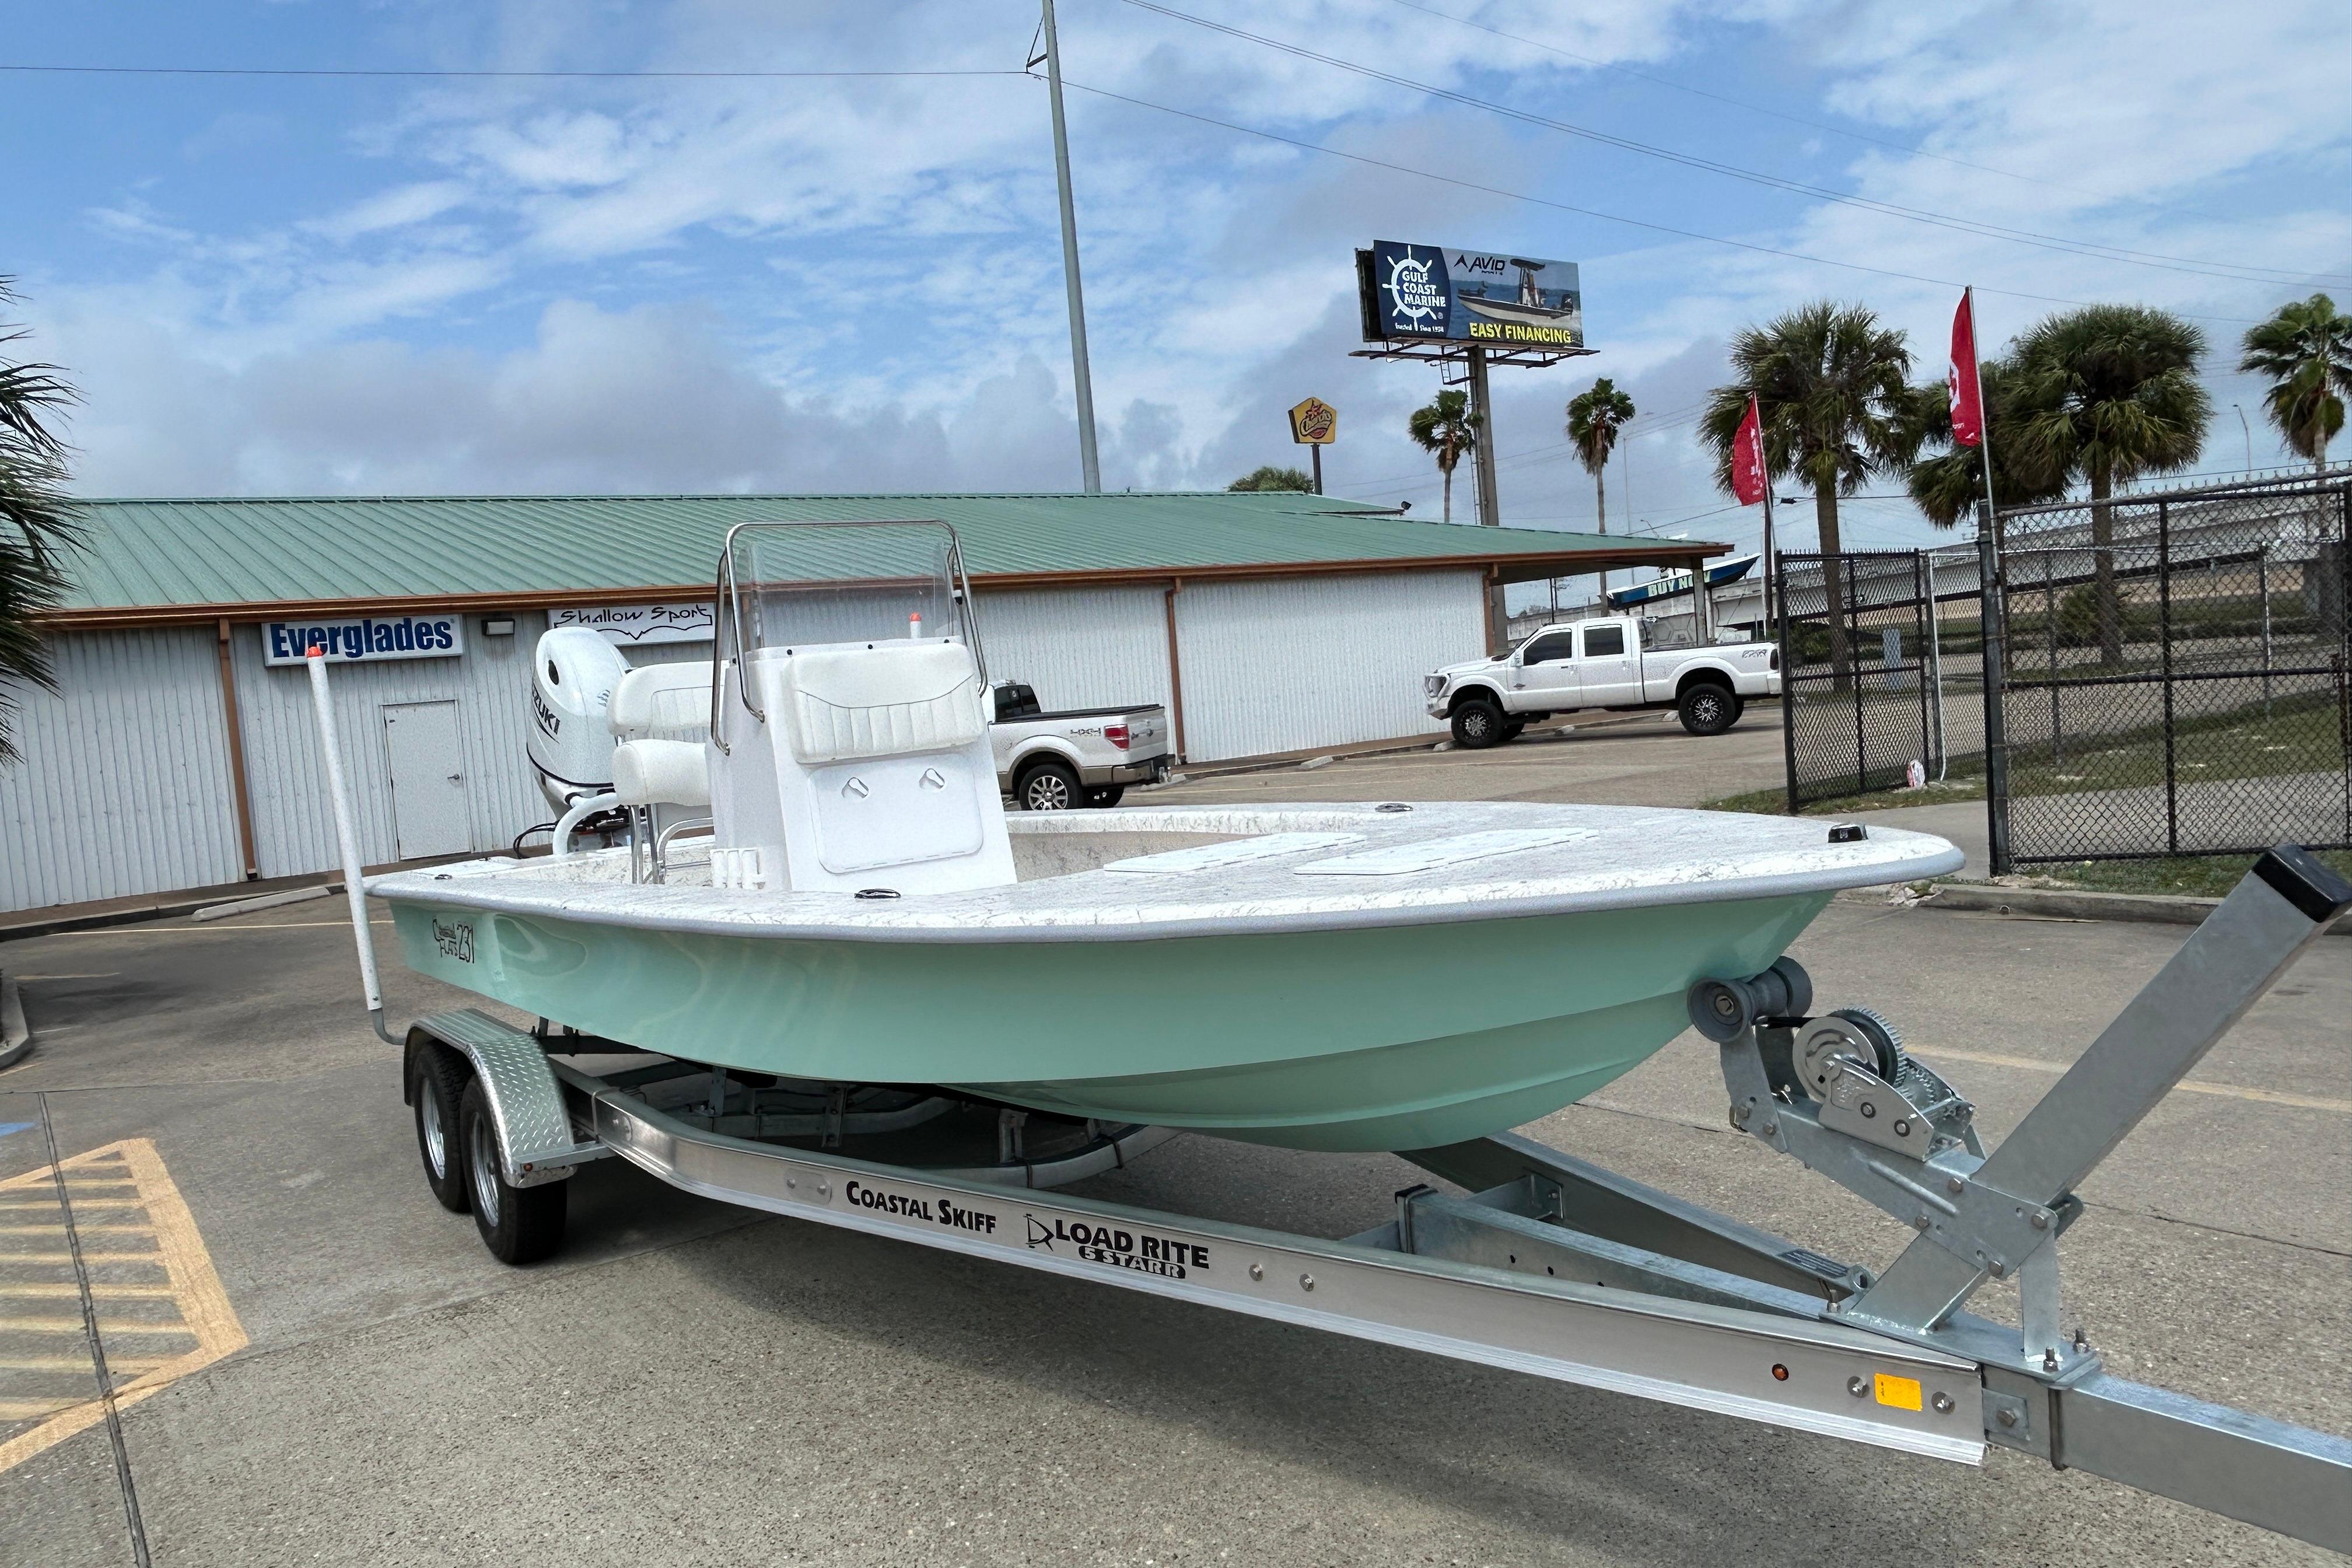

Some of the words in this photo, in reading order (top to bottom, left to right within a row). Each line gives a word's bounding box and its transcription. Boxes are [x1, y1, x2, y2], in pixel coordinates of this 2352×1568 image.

[1402, 271, 1428, 283] GULF
[1403, 282, 1436, 295] COAST
[1404, 293, 1446, 307] MARINE
[1469, 323, 1501, 338] EASY
[1505, 325, 1572, 343] FINANCING
[558, 609, 643, 624] Shallow
[651, 604, 707, 622] Sport
[270, 618, 453, 658] Everglades
[846, 1181, 933, 1221] COASTAL
[938, 1199, 996, 1234] SKIFF
[1055, 1219, 1133, 1252] LOAD
[1141, 1235, 1209, 1269] RITE
[1084, 1247, 1096, 1259] 5
[1102, 1251, 1180, 1278] STARR
